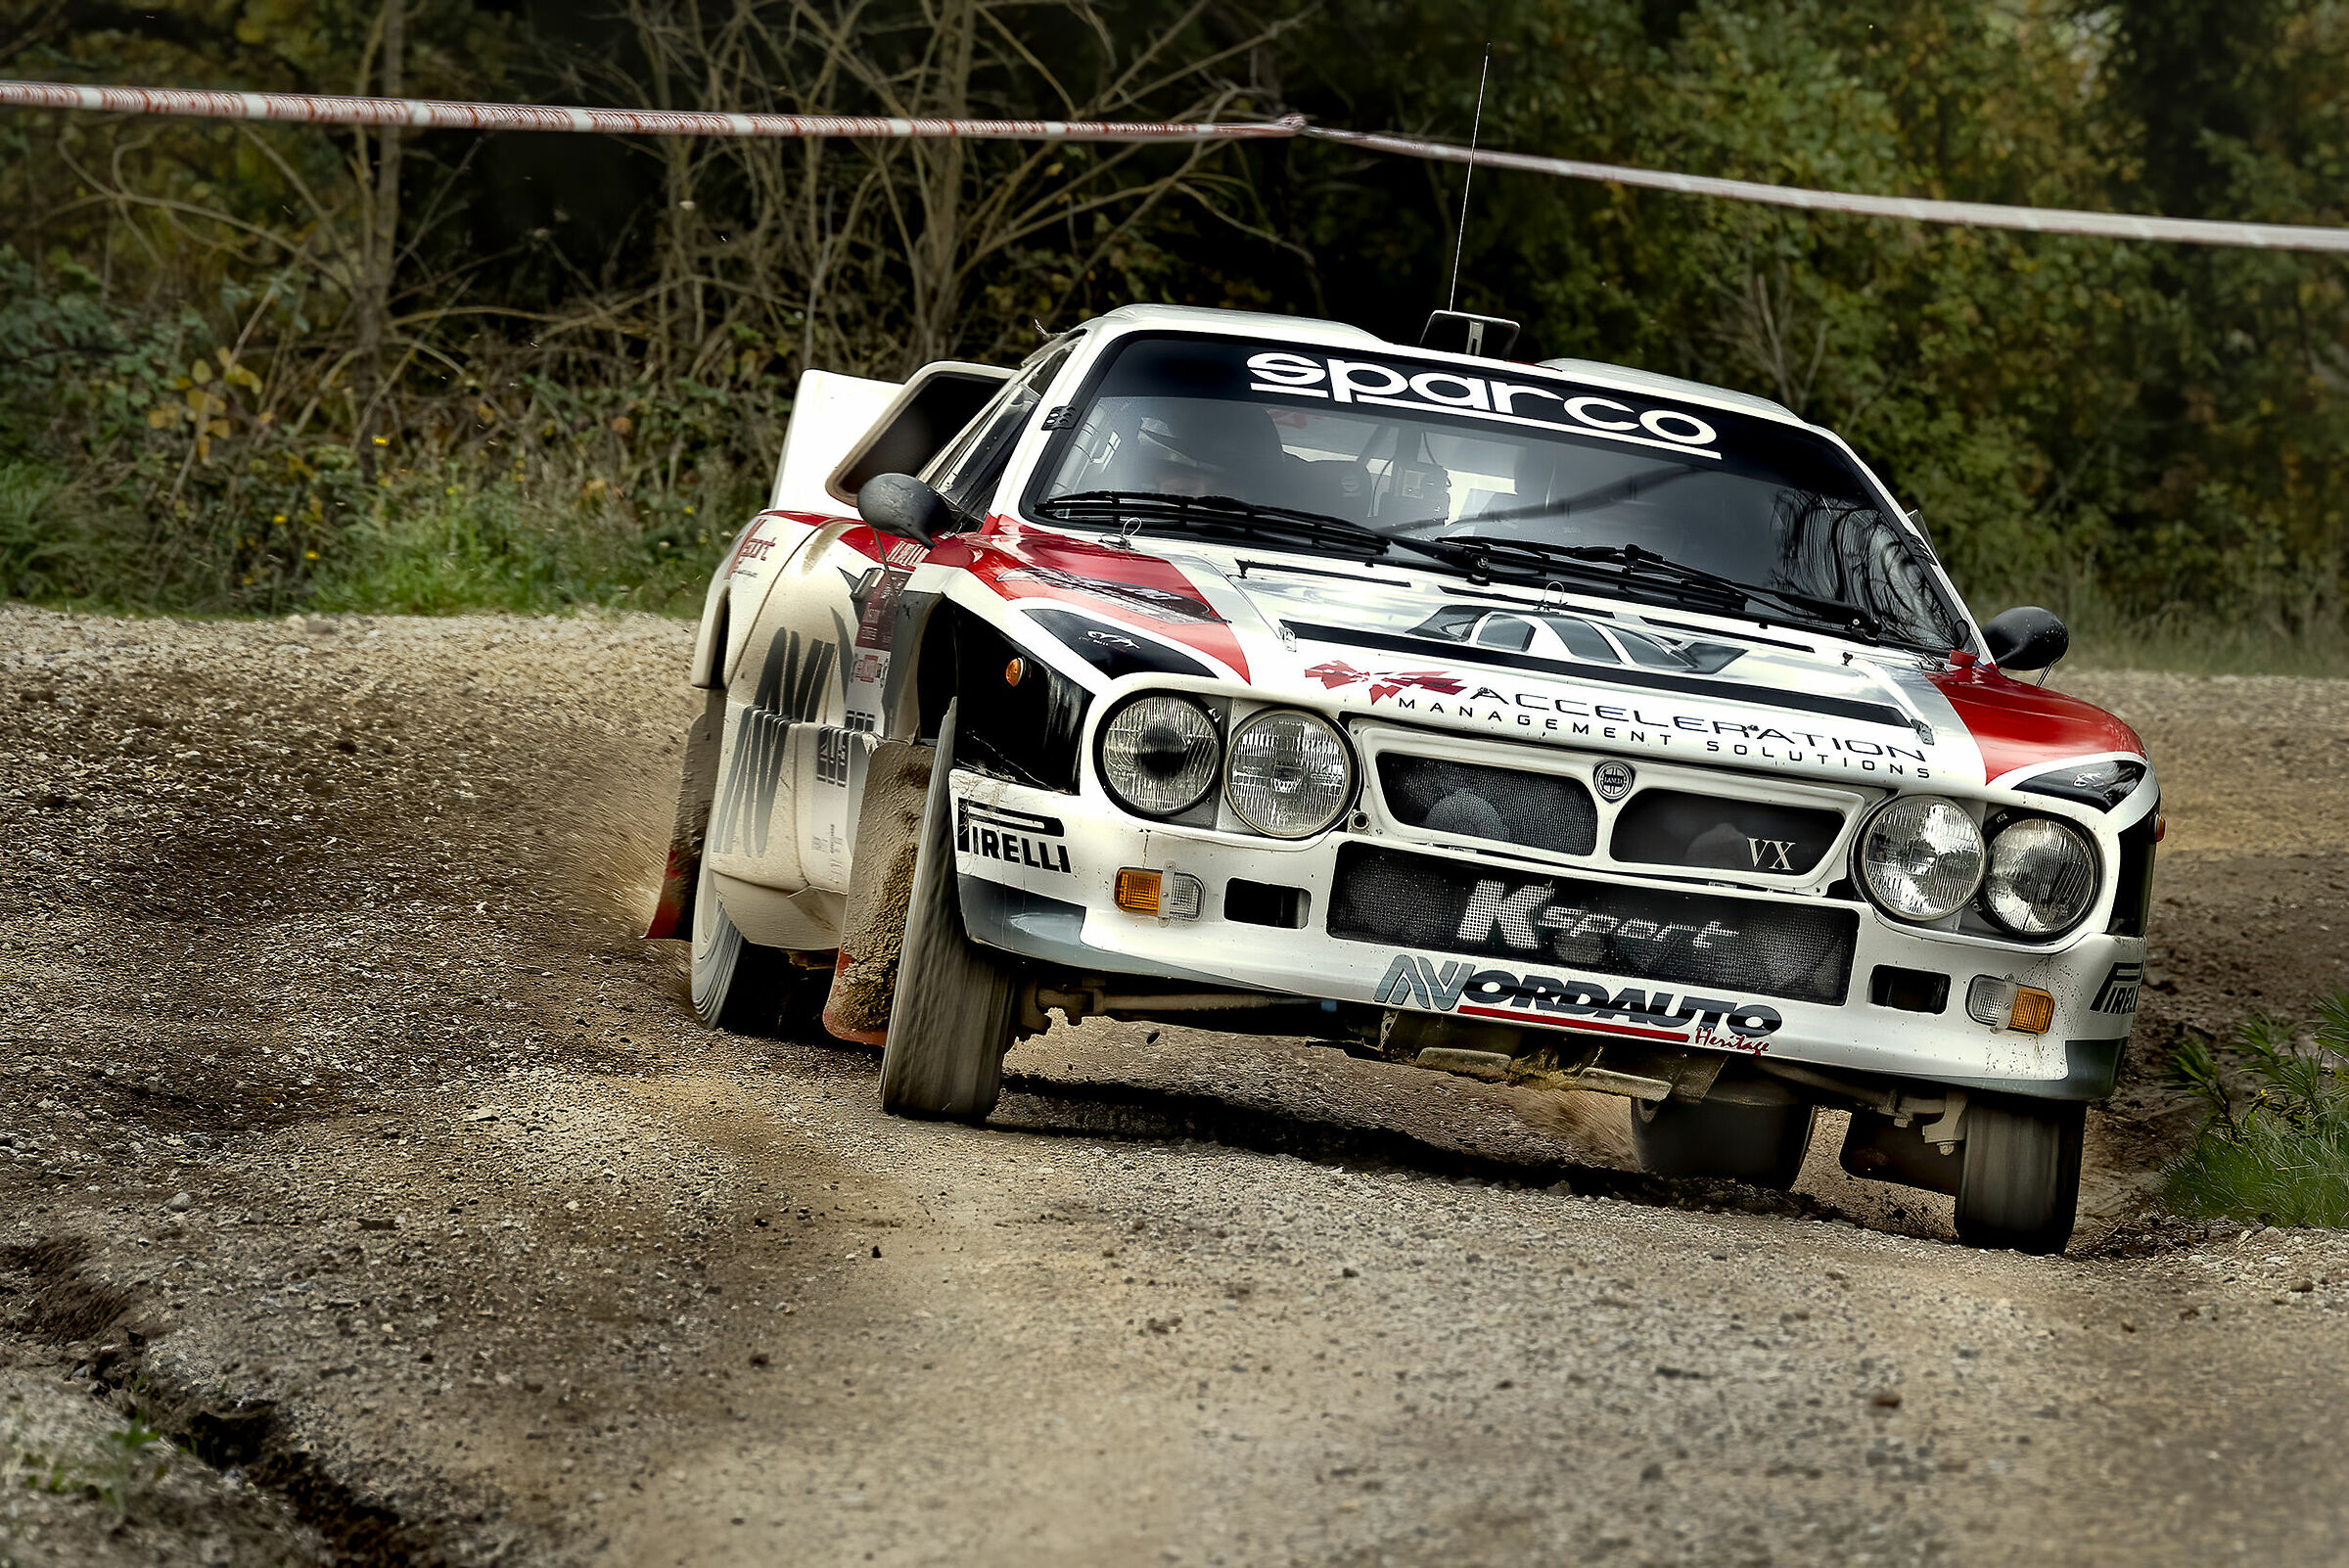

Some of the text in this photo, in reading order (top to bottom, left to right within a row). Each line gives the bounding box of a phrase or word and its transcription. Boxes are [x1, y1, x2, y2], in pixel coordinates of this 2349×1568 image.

[1246, 352, 1718, 445] sparco
[1398, 697, 1930, 779] MANAGEMENT SOLUTIONS
[1469, 687, 1927, 762] ACCELERATION
[957, 796, 1073, 874] PIRELLI
[1745, 837, 1796, 871] VX
[1372, 953, 1782, 1038] NORDAUTO
[1694, 1026, 1771, 1055] Heritage
